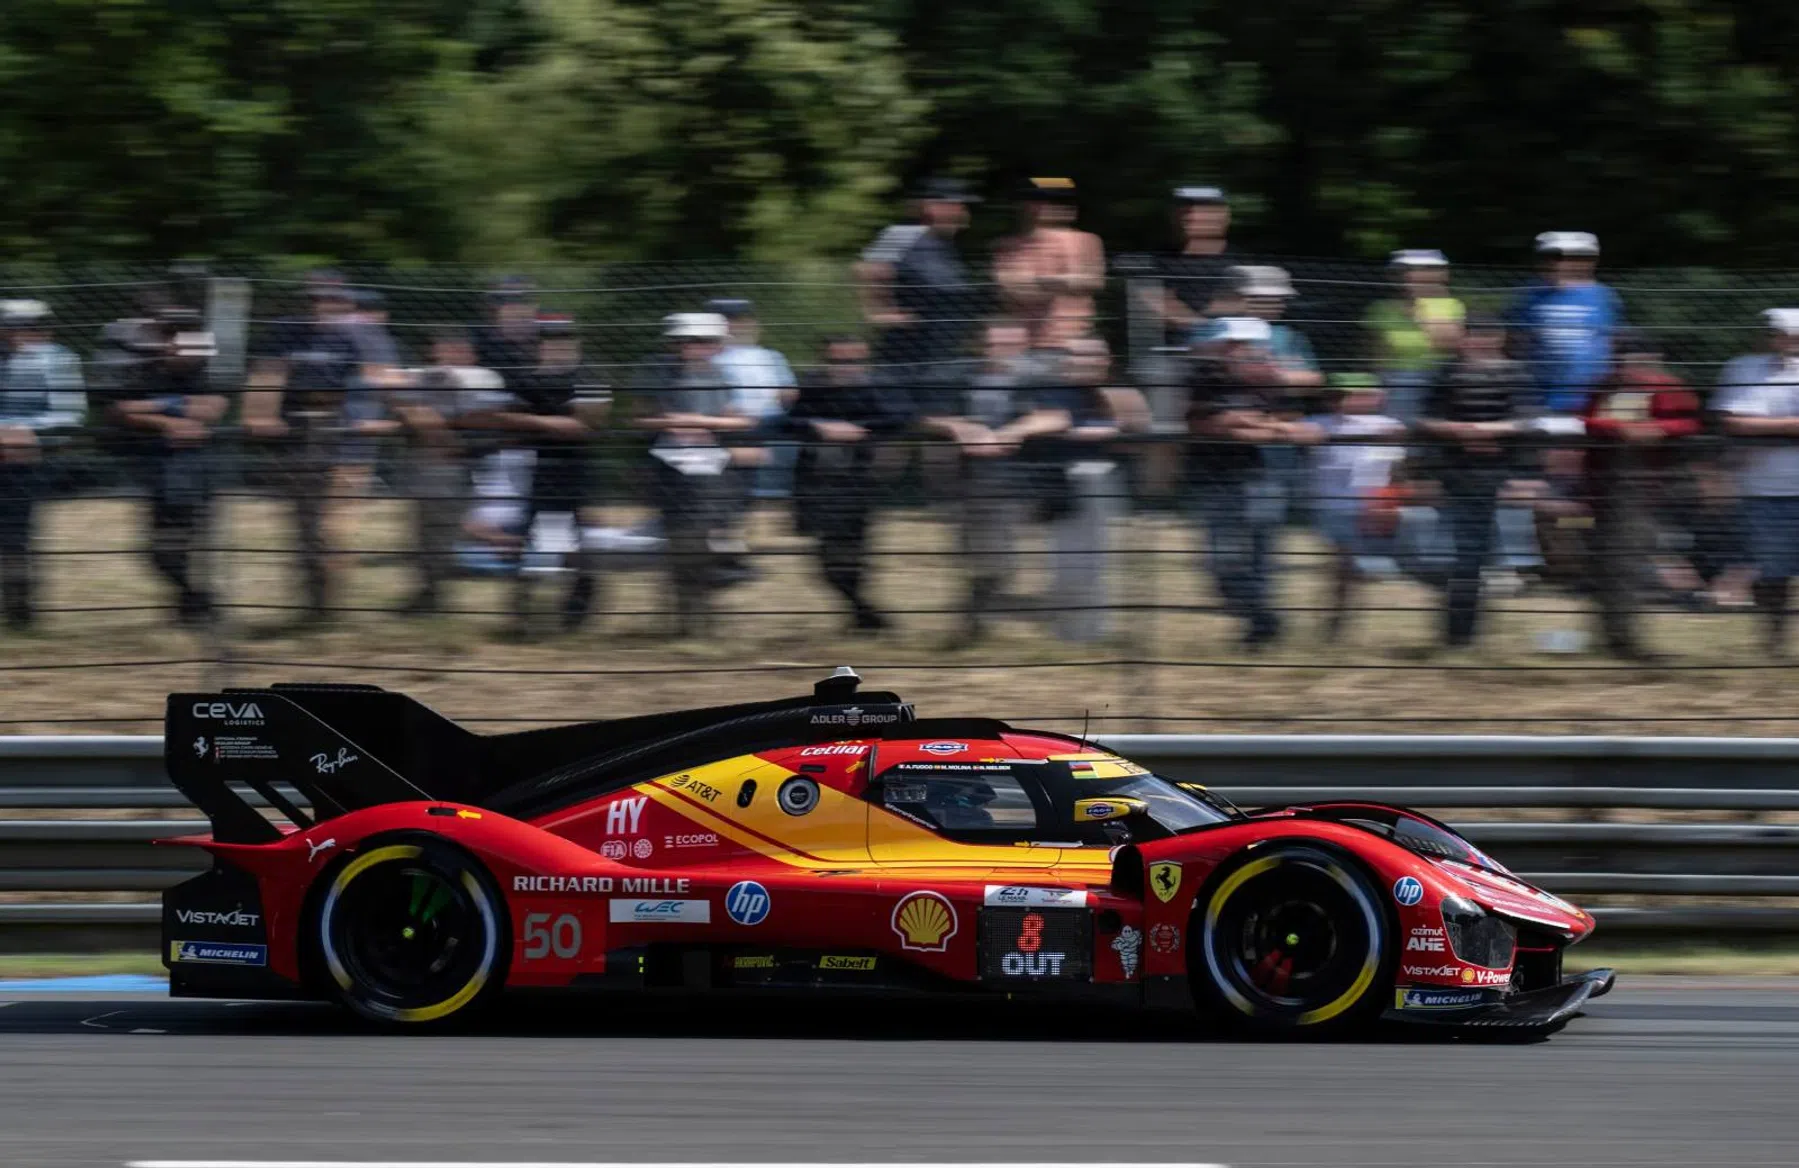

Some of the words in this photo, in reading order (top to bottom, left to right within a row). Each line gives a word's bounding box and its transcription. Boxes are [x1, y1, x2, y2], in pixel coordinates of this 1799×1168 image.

[810, 715, 845, 724] ADLER
[862, 715, 897, 723] GROUP
[309, 747, 358, 773] Ray-Ban
[685, 780, 722, 802] AT&T
[606, 796, 648, 834] HY
[676, 834, 719, 844] ECOPOL
[602, 845, 625, 857] FIA
[513, 876, 613, 892] RICHARD
[622, 878, 690, 893] MILLE
[1398, 877, 1420, 905] hp
[634, 901, 684, 913] WEC
[732, 881, 765, 925] hp
[524, 913, 582, 960] 50
[1017, 912, 1044, 952] 8
[1411, 924, 1444, 936] azimut
[1406, 937, 1446, 952] AHE
[199, 949, 259, 959] MICHELIN
[826, 956, 871, 969] Sabelt
[1002, 952, 1065, 975] OUT
[1424, 993, 1482, 1004] MICHELIN
